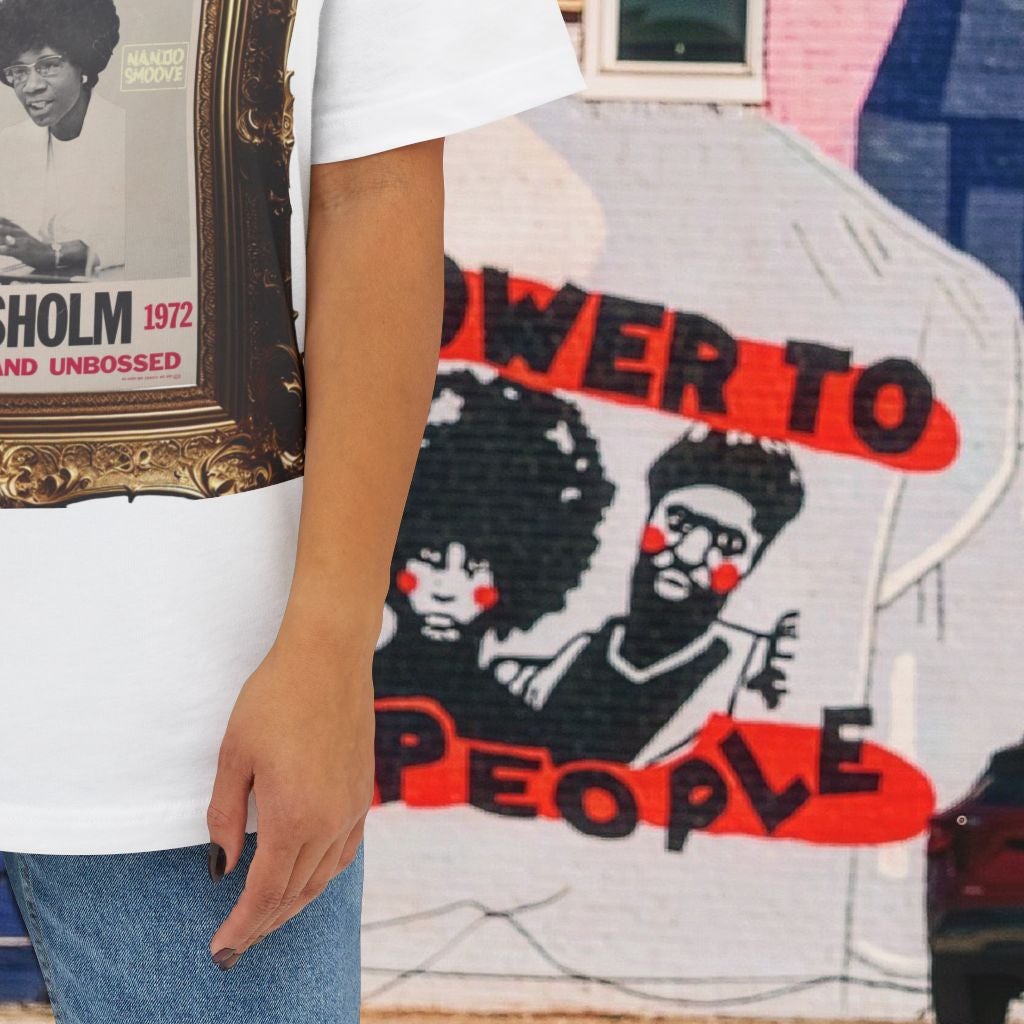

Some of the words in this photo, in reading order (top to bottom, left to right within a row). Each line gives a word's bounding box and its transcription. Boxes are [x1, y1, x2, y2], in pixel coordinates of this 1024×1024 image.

[127, 47, 185, 67] NANDO
[124, 65, 184, 85] SMOOVE
[143, 301, 193, 331] 1972
[49, 351, 182, 376] UNBOSSED
[784, 338, 935, 456] TO
[374, 706, 883, 854] PEOPLE
